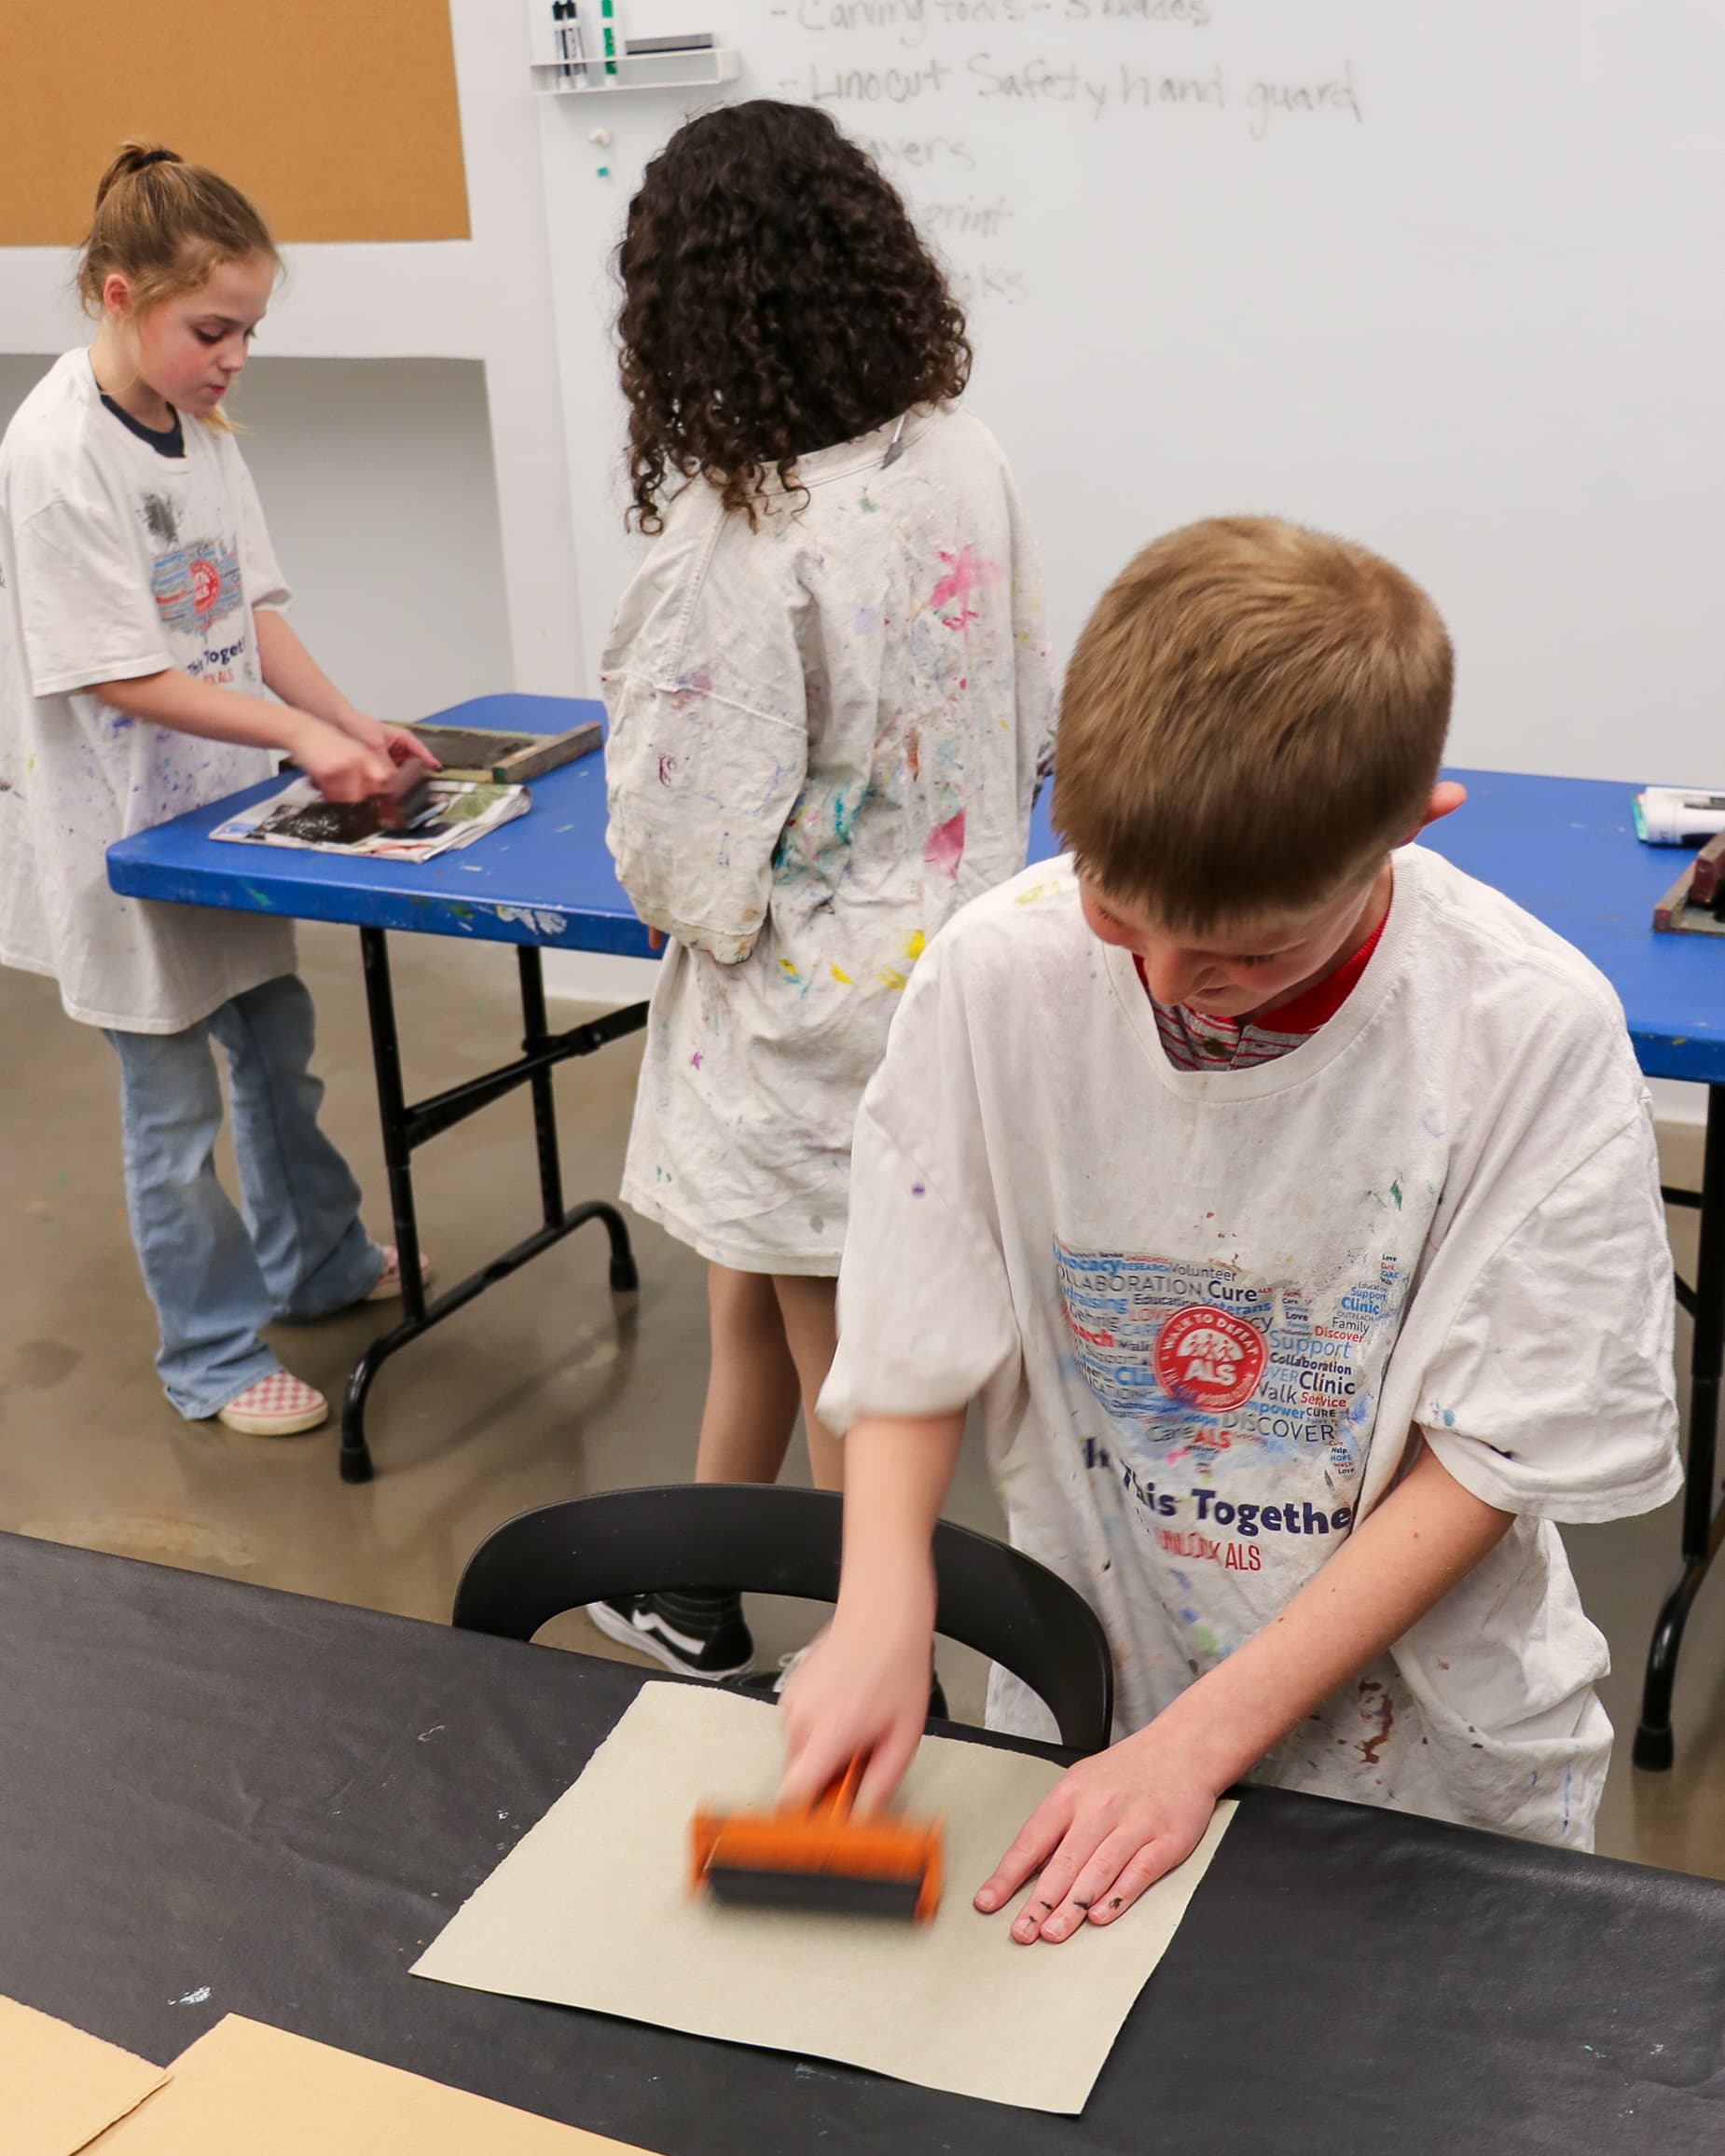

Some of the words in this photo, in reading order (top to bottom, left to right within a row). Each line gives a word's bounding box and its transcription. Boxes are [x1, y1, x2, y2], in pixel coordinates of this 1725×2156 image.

[1119, 62, 1224, 108] hand
[1245, 58, 1363, 141] guard
[1056, 1264, 1202, 1296] OLLABORATION
[1208, 1280, 1258, 1302] Cure
[1171, 1263, 1236, 1282] Volunteer
[1350, 1286, 1387, 1303] Support
[1286, 1311, 1309, 1322] Love
[1341, 1296, 1381, 1316] Clinic
[1194, 1313, 1214, 1325] TO
[1215, 1317, 1260, 1356] DEFEAT
[1314, 1325, 1364, 1344] Discover
[1332, 1317, 1371, 1336] Family
[1269, 1328, 1352, 1360] Support
[1182, 1358, 1237, 1387] ALS
[1269, 1352, 1353, 1376] Collaboration
[1299, 1370, 1357, 1396] Clinic
[1245, 1400, 1305, 1420] mpower
[1305, 1406, 1336, 1418] CURE
[1300, 1390, 1348, 1409] Service
[1193, 1427, 1232, 1449] ALS
[1221, 1412, 1336, 1443] DISCOVER
[1330, 1454, 1353, 1462] HOPE
[1331, 1446, 1348, 1455] Help
[1192, 1487, 1353, 1537] Togethe
[1225, 1542, 1261, 1571] ALS
